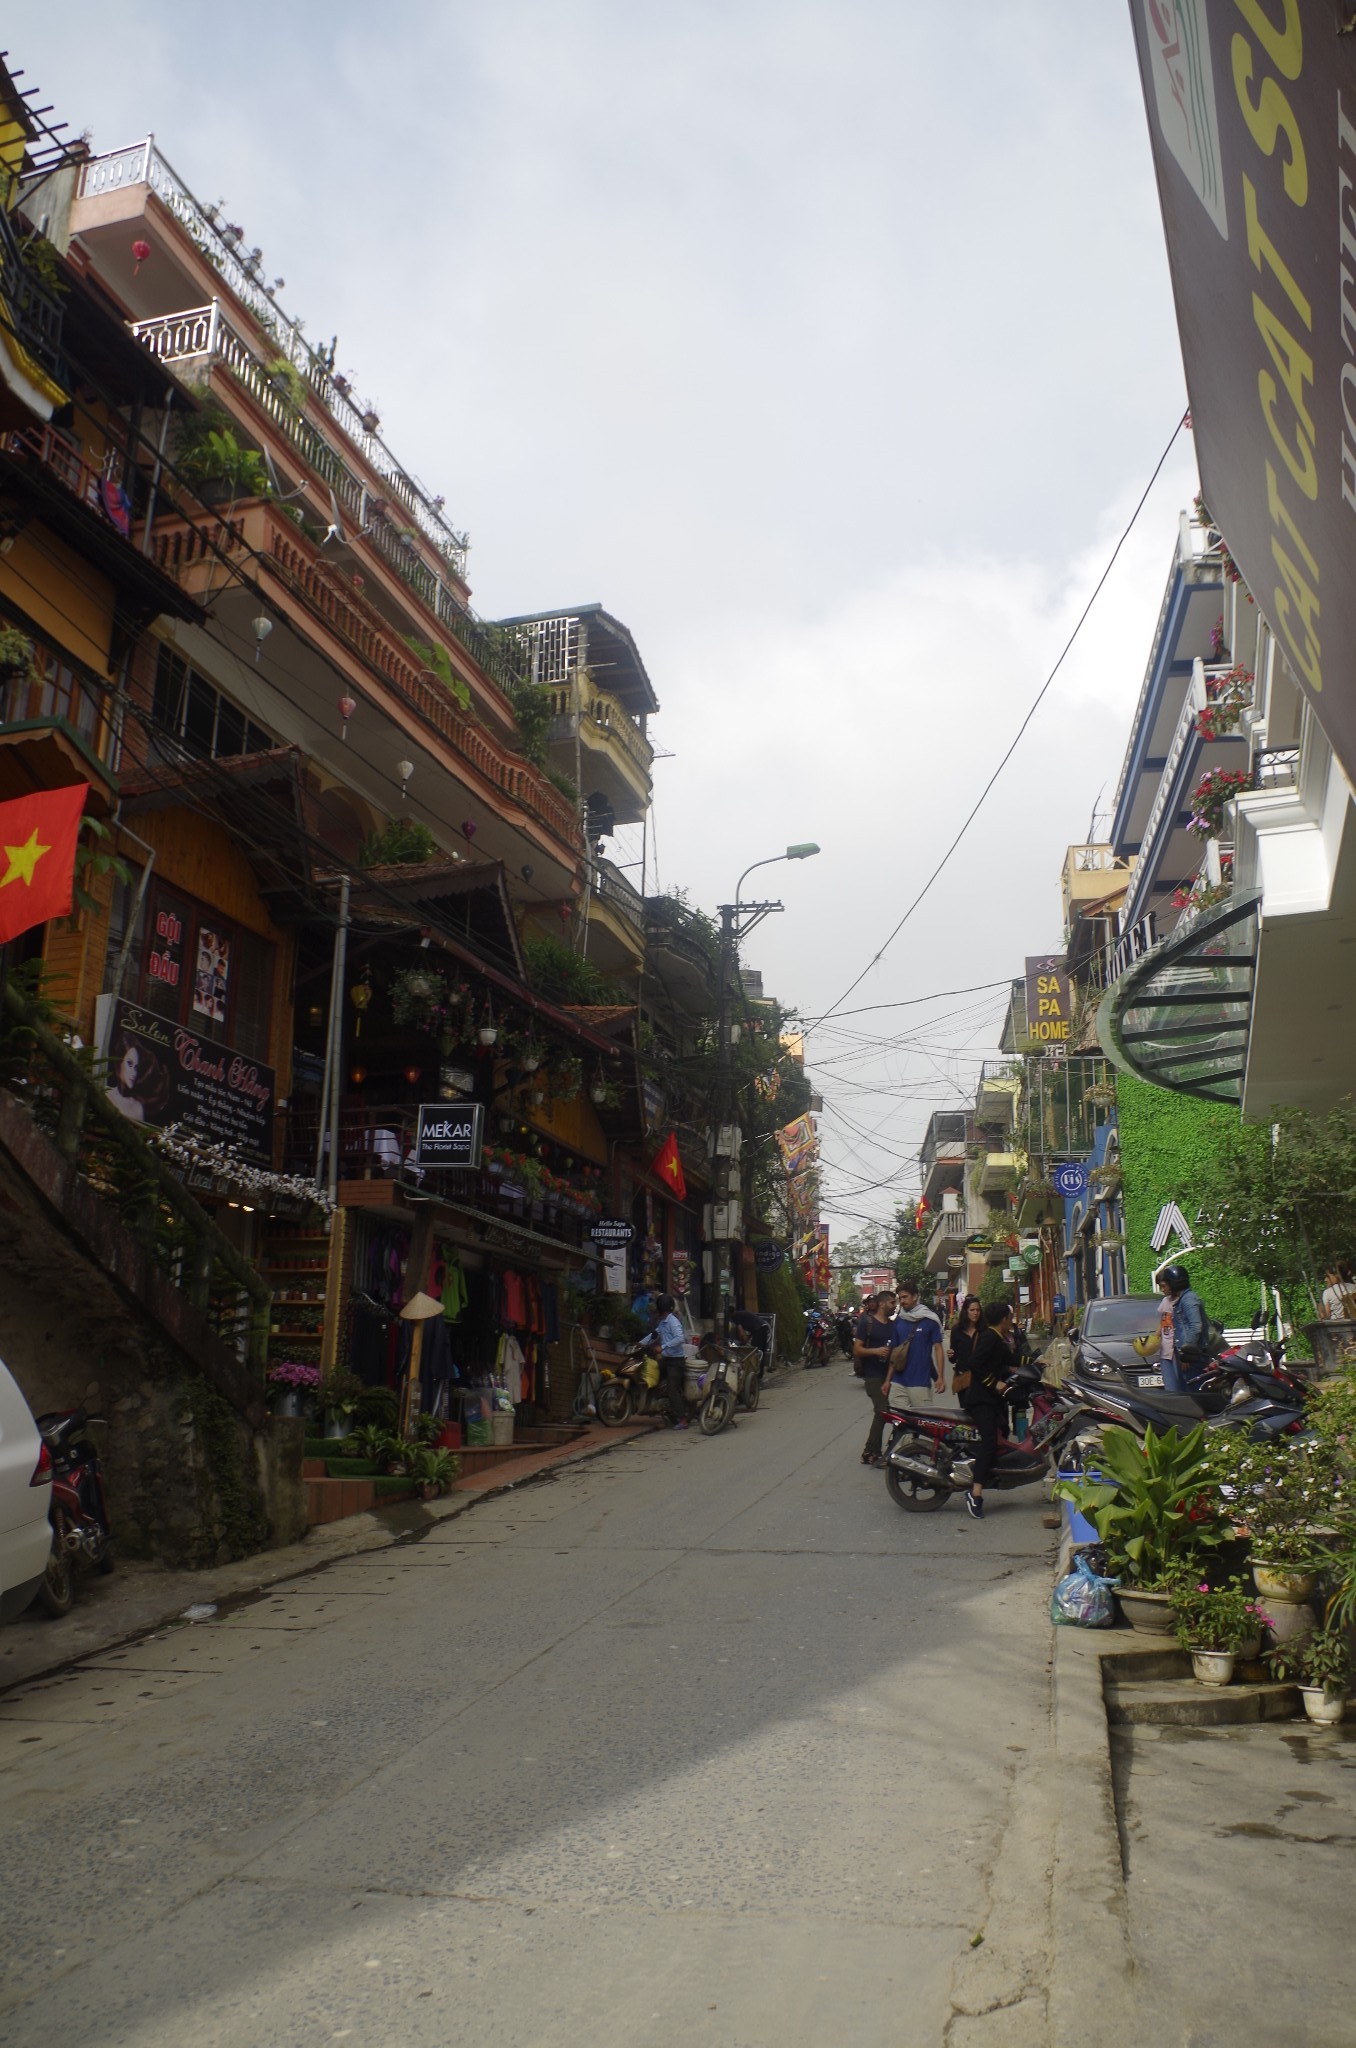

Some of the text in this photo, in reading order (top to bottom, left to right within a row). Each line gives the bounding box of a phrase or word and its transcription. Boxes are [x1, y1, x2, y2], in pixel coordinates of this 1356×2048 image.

[1241, 171, 1320, 501] CAT
[1265, 458, 1322, 693] CAT
[1037, 976, 1061, 994] SA
[1038, 999, 1061, 1017] PA
[120, 1007, 171, 1046] Salon
[1029, 1021, 1071, 1040] HOME
[422, 1122, 472, 1138] MEKAR
[452, 1143, 470, 1151] Sapa
[590, 1228, 632, 1237] RESTAURANTS
